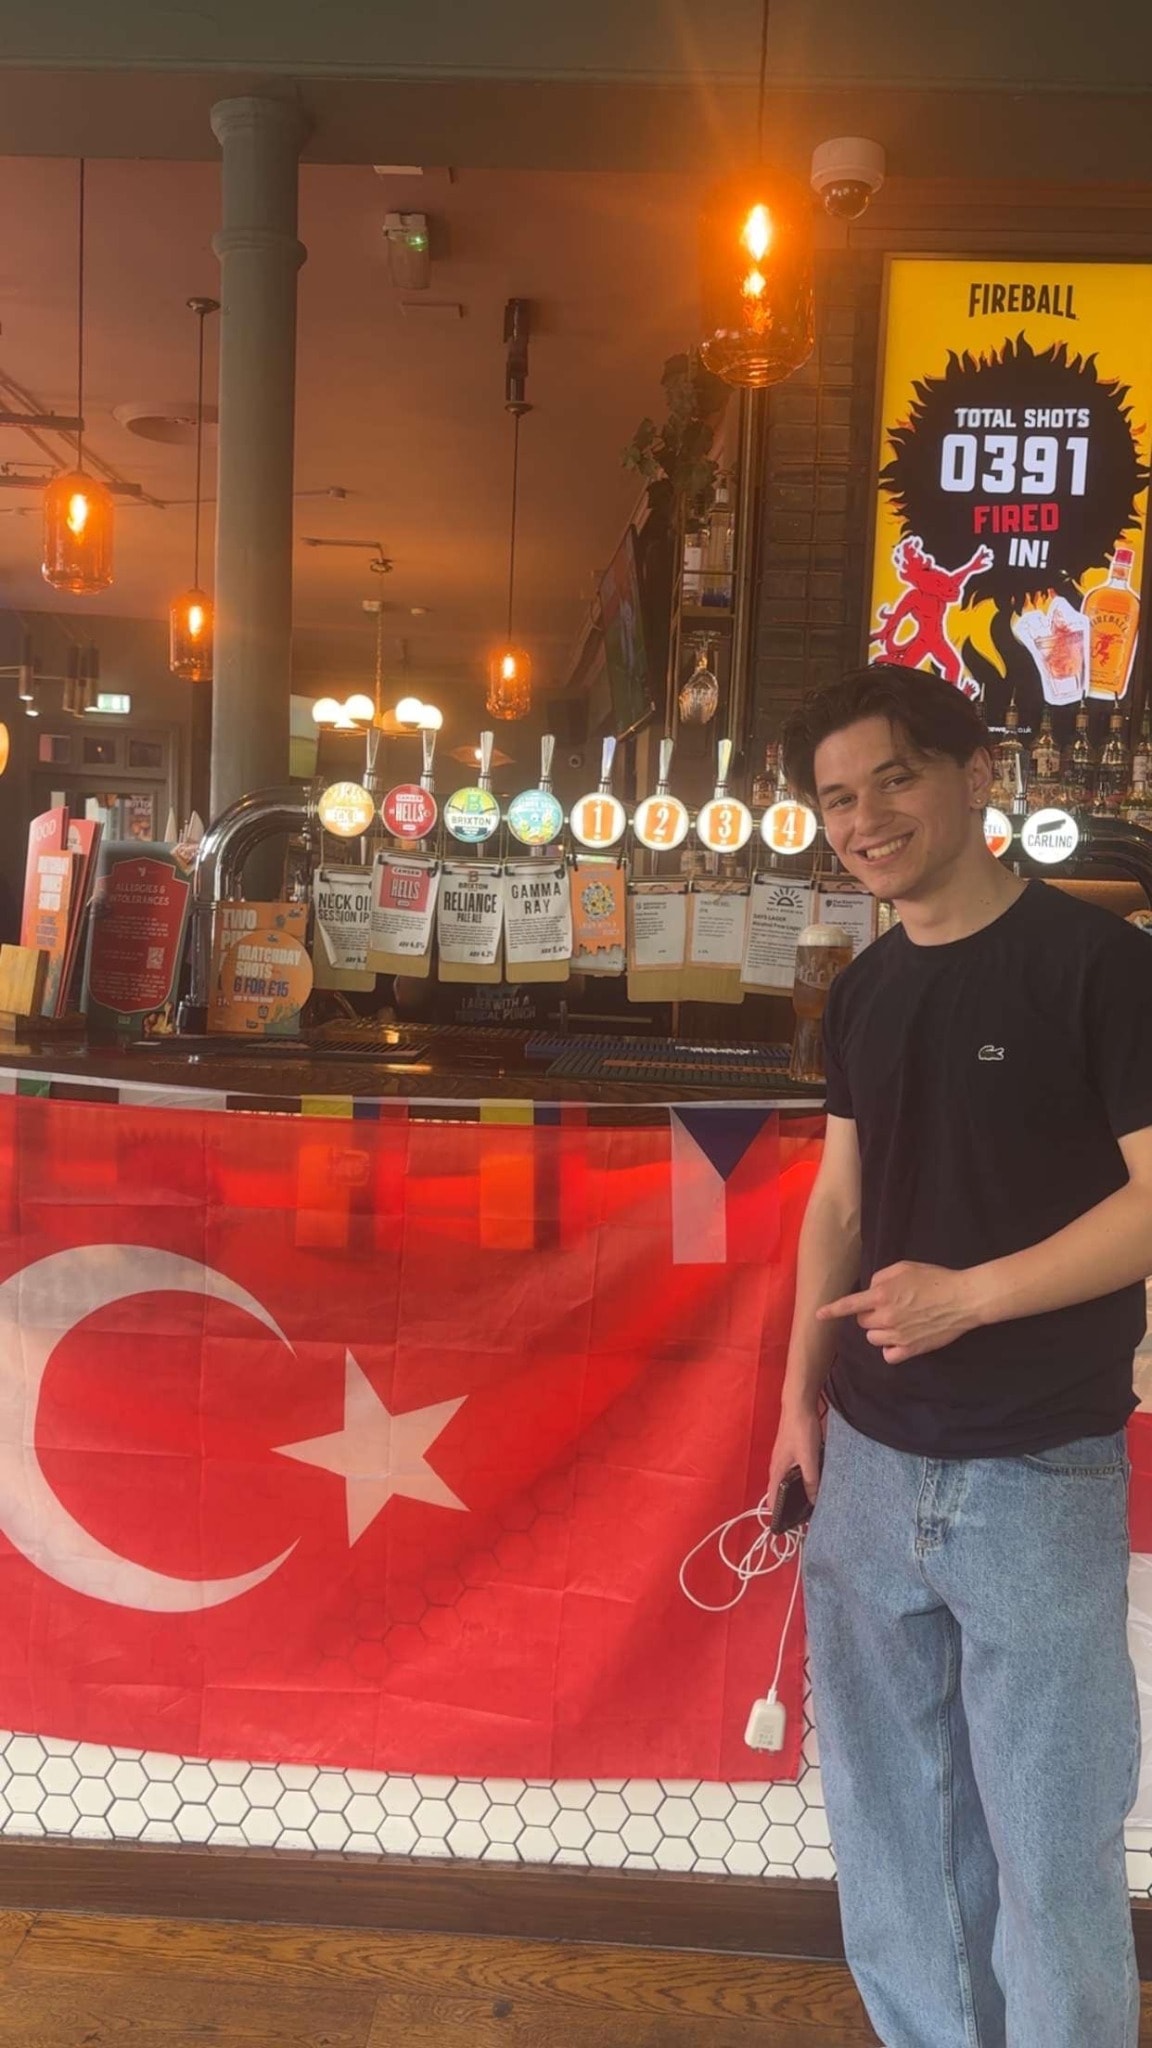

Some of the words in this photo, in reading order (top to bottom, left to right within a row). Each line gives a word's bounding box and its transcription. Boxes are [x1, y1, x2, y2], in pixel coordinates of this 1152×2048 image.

[968, 282, 1077, 320] FIREBALL
[955, 407, 1016, 429] TOTAL
[1024, 408, 1090, 429] SHOTS
[940, 433, 1089, 496] 0391
[973, 503, 1059, 534] FIRED
[1008, 538, 1049, 568] IN!
[395, 802, 425, 822] HELLS
[451, 815, 491, 826] BRIXTON
[593, 803, 602, 834] 1
[656, 807, 670, 837] 2
[717, 809, 733, 838] 3
[781, 812, 797, 840] 4
[1027, 833, 1073, 848] CARLING
[115, 882, 158, 894] ALLERGIES
[159, 885, 166, 894] &
[391, 878, 421, 899] HELLS
[458, 882, 489, 890] BRIXTON
[511, 882, 562, 900] GAMMA
[318, 893, 352, 911] NECK
[443, 891, 498, 913] RELIANCE
[524, 899, 551, 915] RAY
[222, 908, 258, 929] TWO
[318, 909, 357, 923] SESSION
[457, 912, 471, 922] PALE
[472, 913, 482, 923] ALE
[768, 914, 786, 922] LAGER
[237, 945, 301, 965] MATCHDAY
[235, 961, 273, 979] SHOTS
[233, 976, 242, 993] 6
[244, 978, 266, 994] FOR
[268, 981, 289, 997] £15
